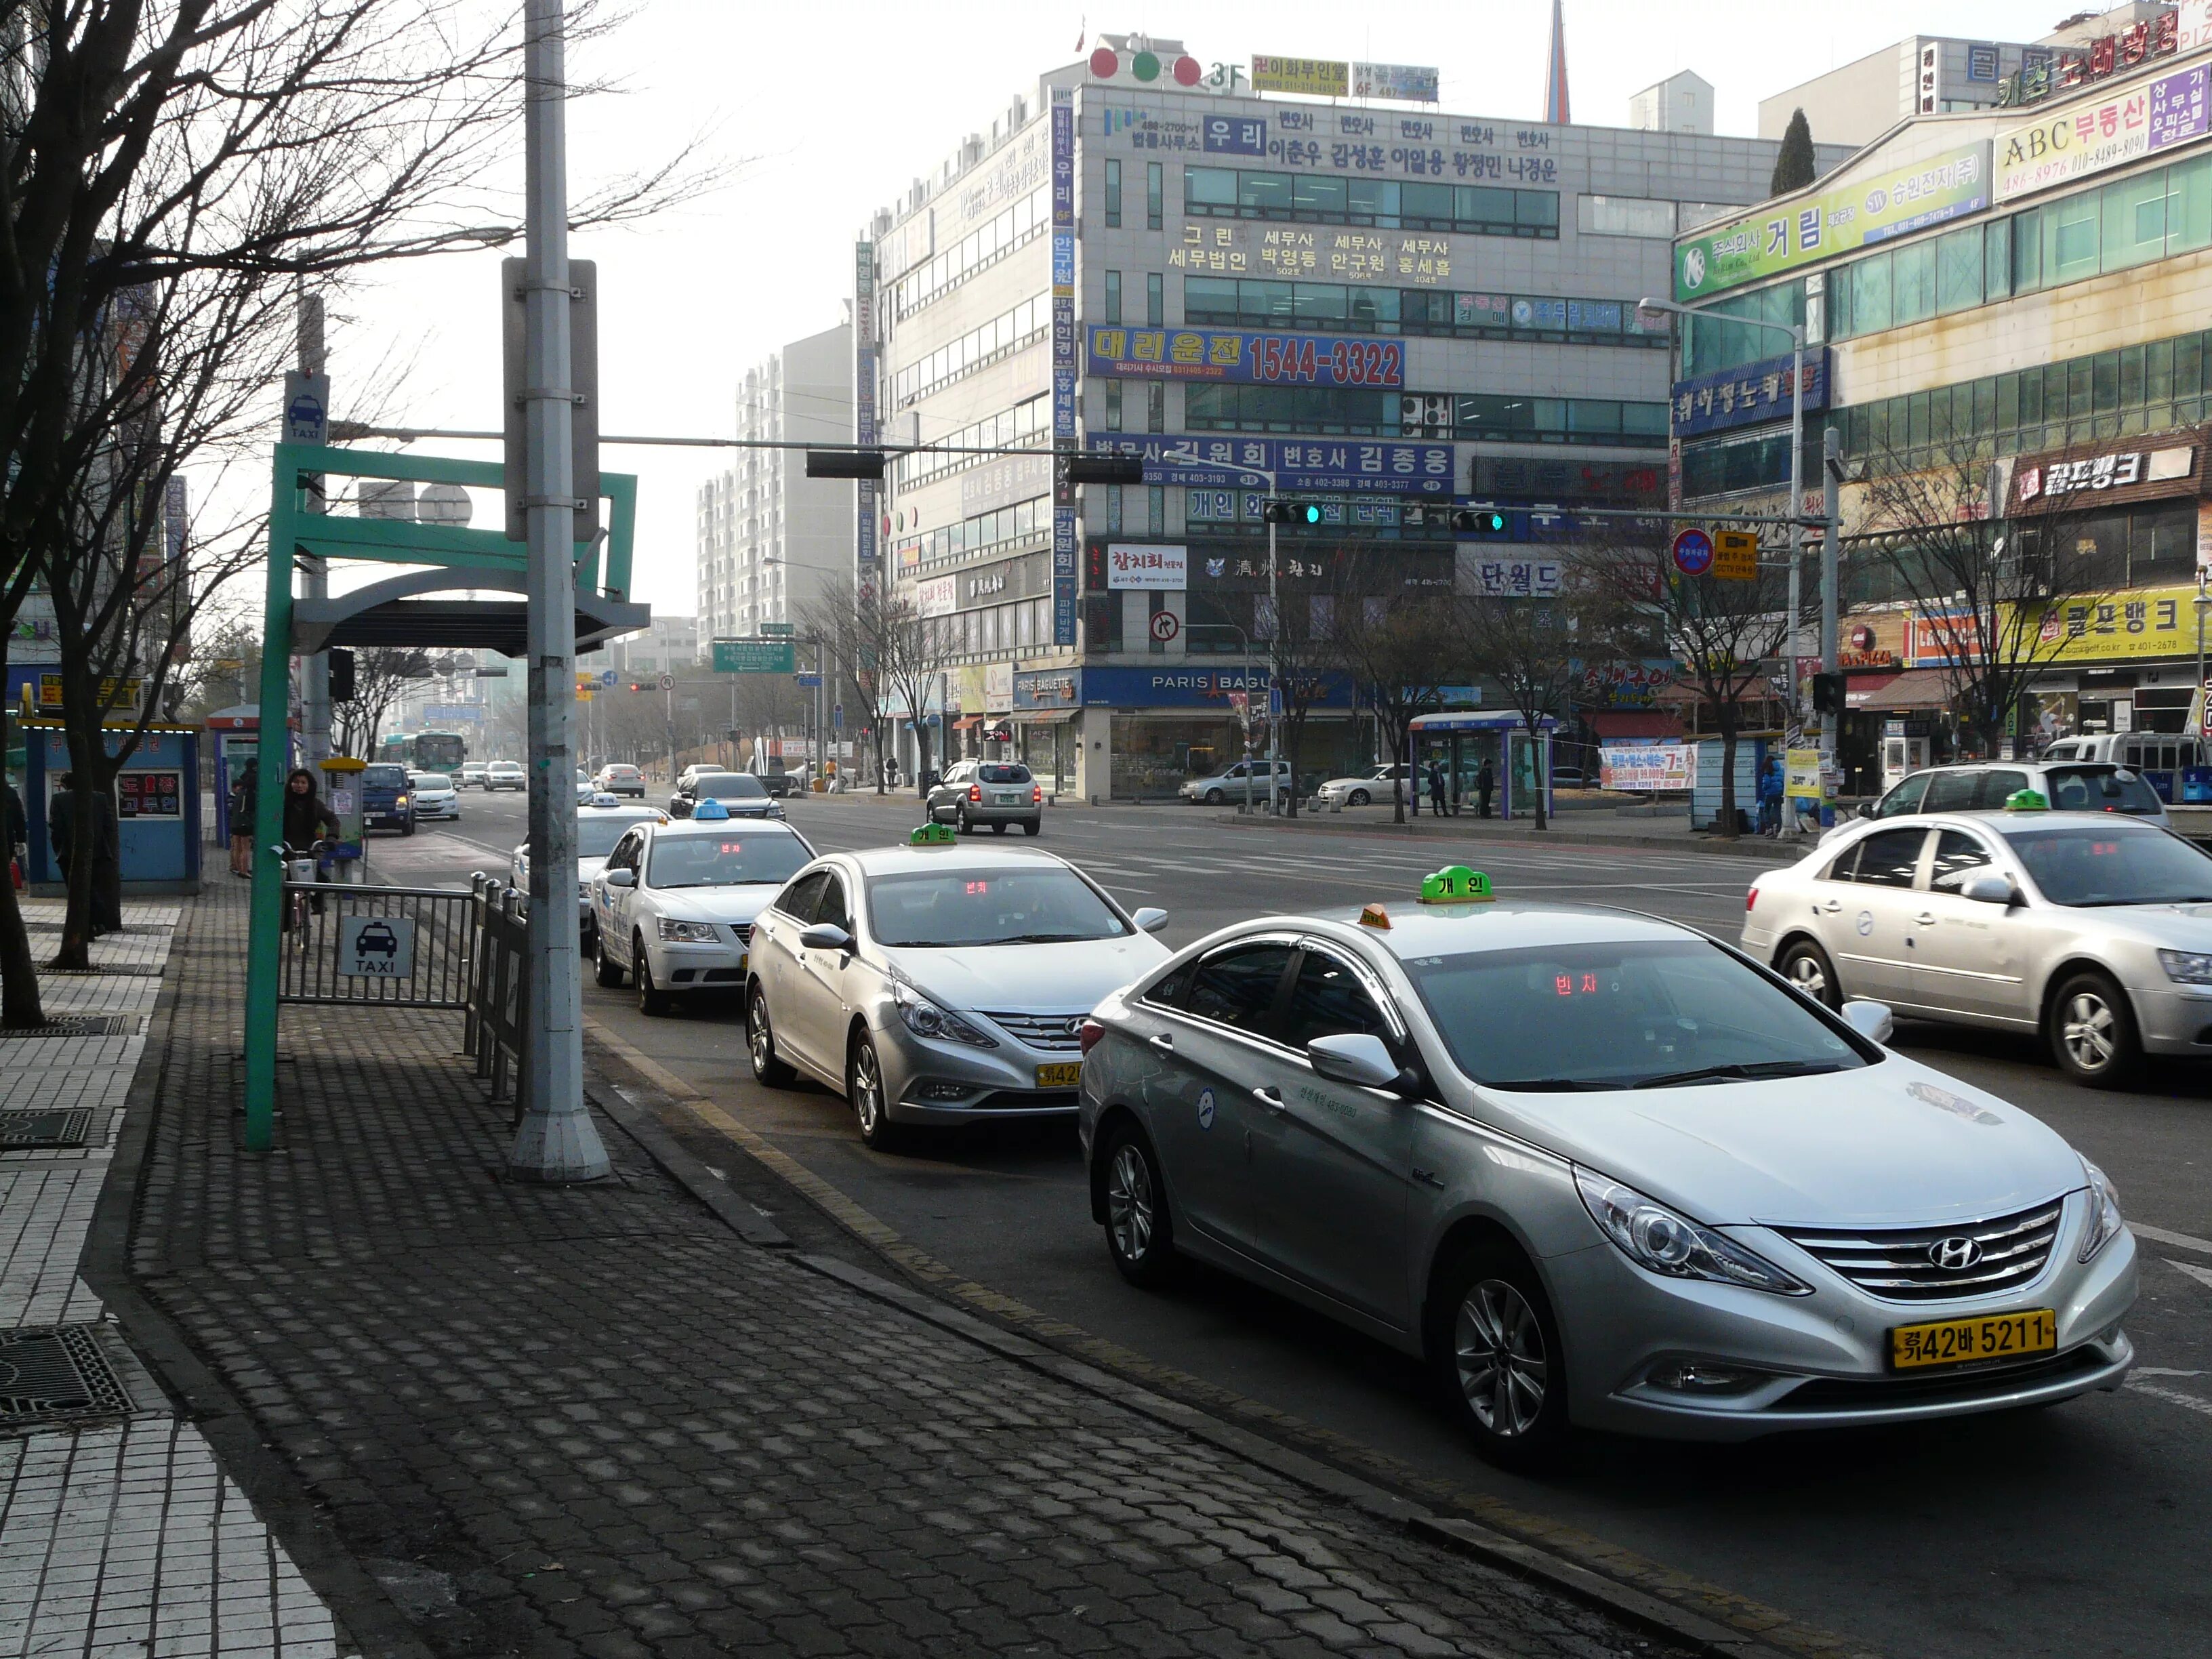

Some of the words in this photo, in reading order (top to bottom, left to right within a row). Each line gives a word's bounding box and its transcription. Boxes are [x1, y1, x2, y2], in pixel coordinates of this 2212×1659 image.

[1210, 62, 1245, 89] 3F
[1355, 81, 1372, 96] 6F
[2152, 86, 2203, 115] 사무실
[1209, 120, 1261, 150] 우리
[1516, 129, 1550, 150] 변호사
[2004, 121, 2068, 167] ABC
[2075, 94, 2146, 144] 부동산
[1055, 161, 1071, 204] 우리
[1183, 225, 1233, 247] 그린
[1264, 230, 1315, 247] 세무사
[1334, 234, 1383, 251] 세무사
[1401, 238, 1450, 256] 세무사
[1712, 228, 1761, 263] 주식회사
[1766, 206, 1822, 258] 거림
[1054, 237, 1072, 284] 안구원
[1168, 248, 1248, 272] 세무법인
[1261, 247, 1317, 268] 박영동
[1331, 253, 1385, 272] 안구원
[1092, 329, 1244, 367] 대리운전
[1248, 337, 1401, 386] 1544-3322
[1115, 362, 1144, 373] 대리기사
[1145, 363, 1172, 375] 수시모집
[292, 428, 319, 439] TAXI
[1284, 446, 1347, 470] 변호사
[1359, 446, 1448, 474] 김종웅
[1191, 491, 1234, 519] 개인
[1112, 552, 1163, 571] 참치회
[1481, 562, 1557, 594] 단월드
[1059, 599, 1071, 644] 파리바게뜨
[2067, 598, 2177, 638] 골프뱅크
[2137, 640, 2177, 651] 401-2678
[1017, 680, 1034, 692] PARIS
[1037, 677, 1069, 691] BAGUETTE
[1151, 676, 1208, 688] PARIS
[122, 796, 176, 812] 고무인
[919, 829, 949, 840] 개인
[1437, 876, 1483, 894] 개인
[355, 960, 394, 973] TAXI
[1556, 972, 1597, 996] 빈차
[1981, 1315, 2043, 1353] 5211
